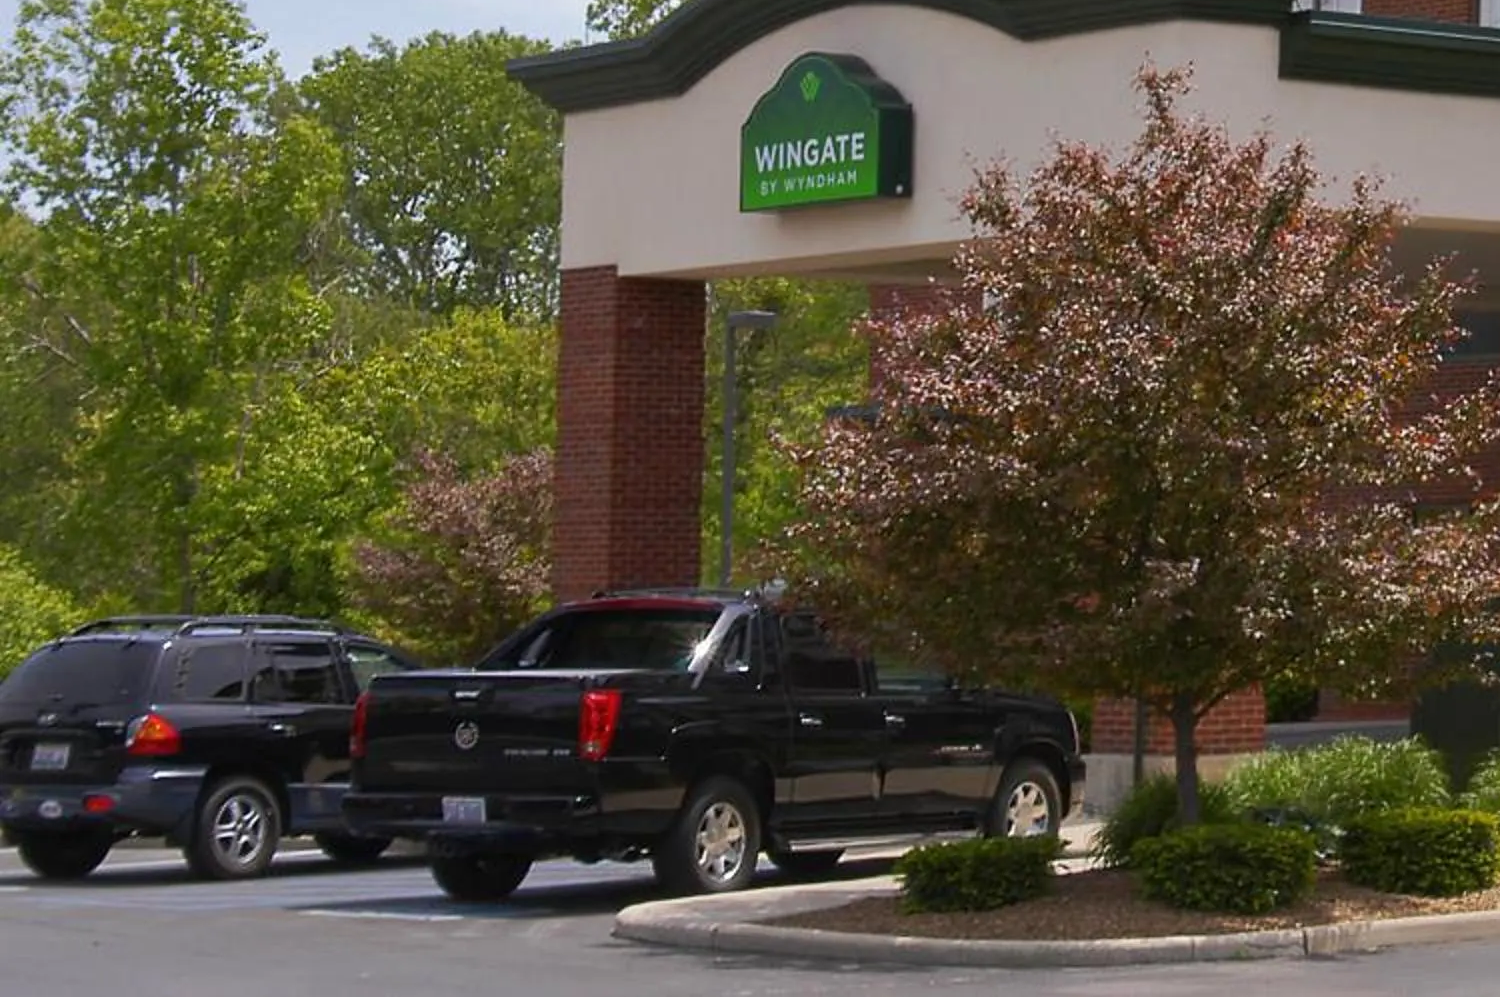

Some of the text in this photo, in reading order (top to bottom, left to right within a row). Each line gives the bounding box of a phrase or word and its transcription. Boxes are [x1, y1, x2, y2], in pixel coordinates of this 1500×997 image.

[755, 131, 865, 174] WINGATE
[760, 169, 857, 197] BY WYNDHAM
